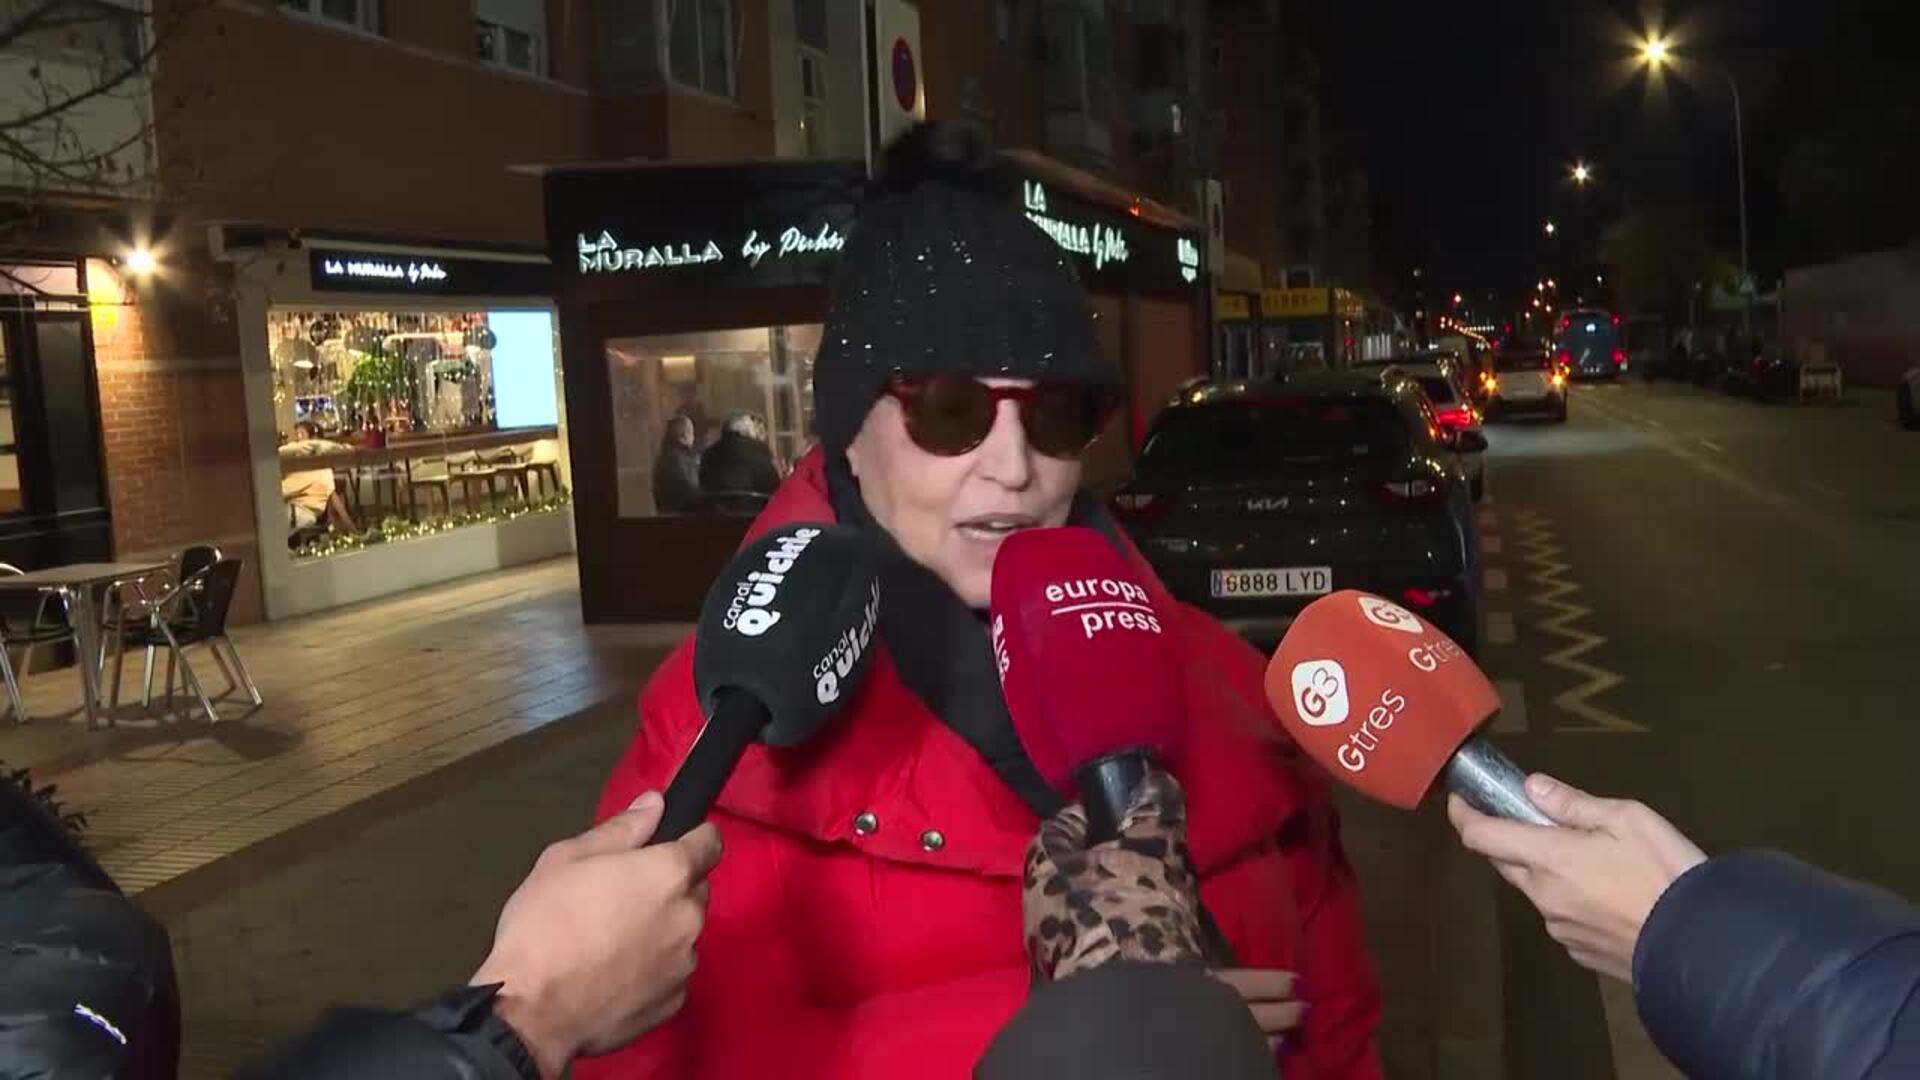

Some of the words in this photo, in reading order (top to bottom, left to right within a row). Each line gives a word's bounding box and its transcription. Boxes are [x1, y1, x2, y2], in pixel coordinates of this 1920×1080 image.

[1024, 180, 1046, 213] LA
[577, 230, 618, 251] LA
[578, 240, 724, 274] MURALLA
[742, 230, 771, 268] by
[325, 259, 344, 275] LA
[1045, 578, 1150, 604] europa
[1285, 570, 1326, 591] LYD
[723, 581, 753, 630] canal
[1080, 610, 1162, 639] press
[813, 629, 849, 680] canal
[1301, 667, 1339, 718] G3
[1337, 688, 1405, 772] Gtres
